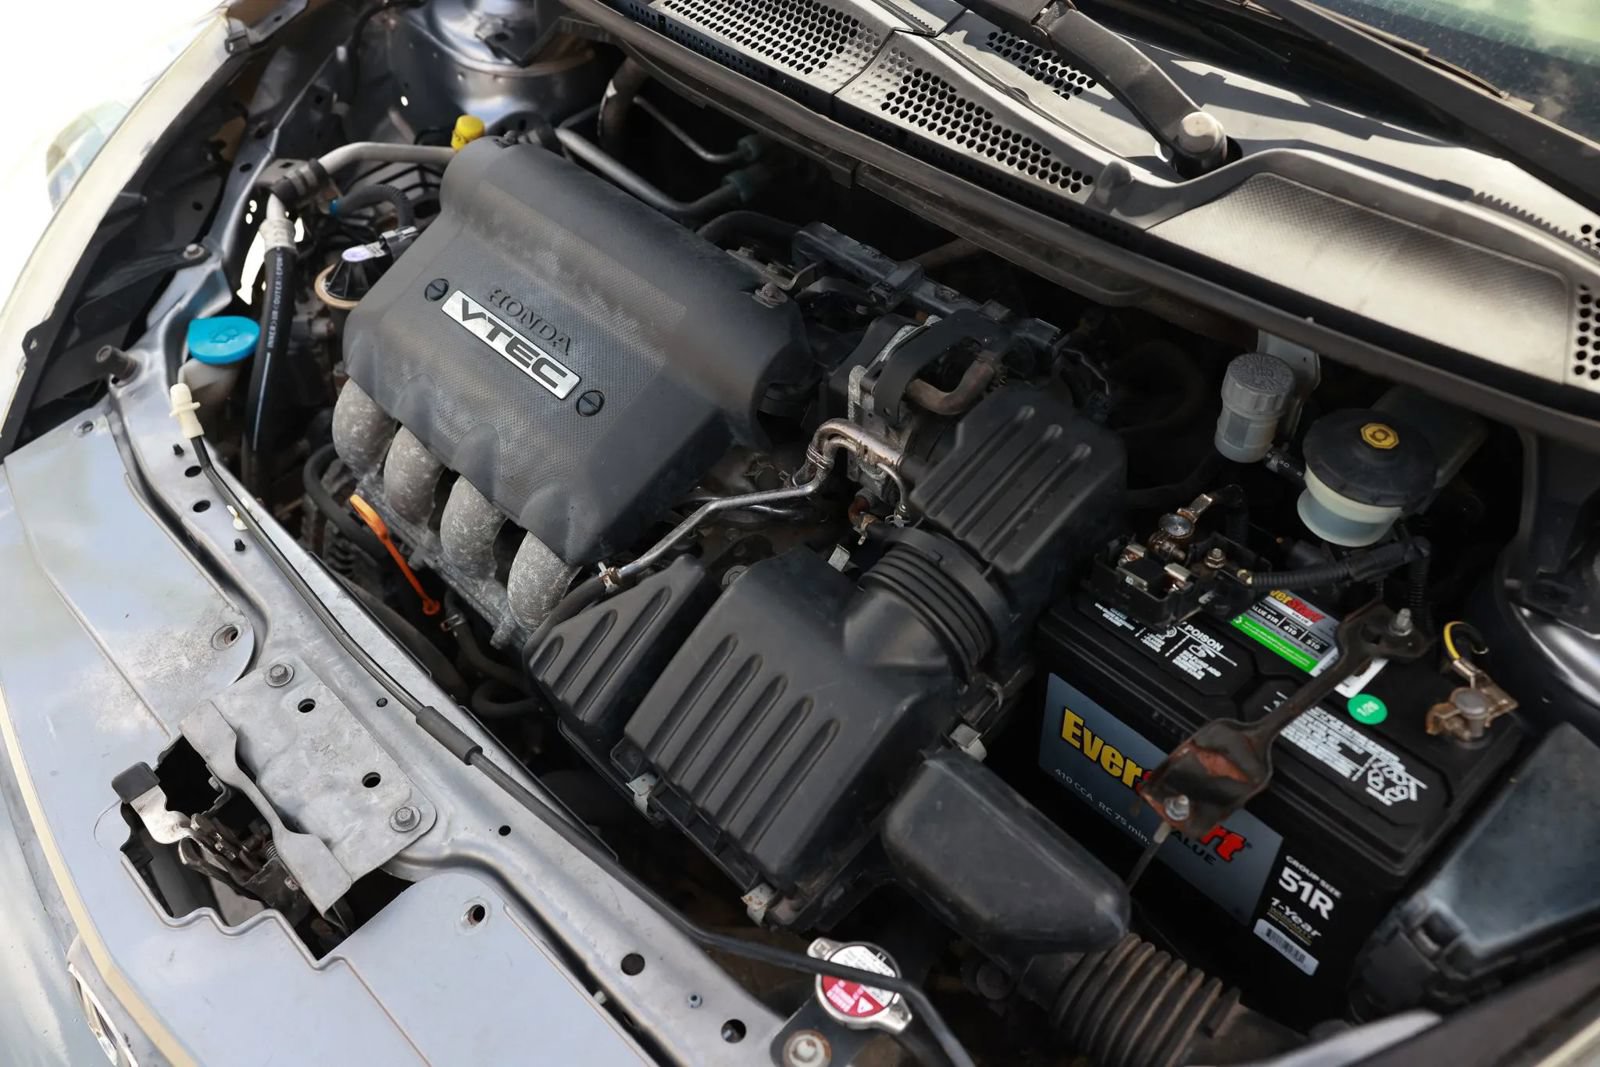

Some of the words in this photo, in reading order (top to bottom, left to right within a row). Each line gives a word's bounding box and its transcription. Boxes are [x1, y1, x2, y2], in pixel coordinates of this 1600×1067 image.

[461, 298, 567, 389] VTEC
[489, 289, 572, 356] HONDA
[1184, 624, 1224, 652] POISON
[1283, 625, 1298, 636] 410
[1305, 639, 1321, 650] 510
[1055, 768, 1073, 784] 410
[1074, 781, 1094, 801] CCA
[1098, 801, 1113, 817] RC
[1114, 812, 1128, 827] 75
[1170, 830, 1217, 866] ALUE
[1279, 866, 1334, 920] 51R
[1286, 855, 1320, 881] GROUP
[1320, 879, 1342, 899] SIZE
[1271, 897, 1322, 937] 1-Year
